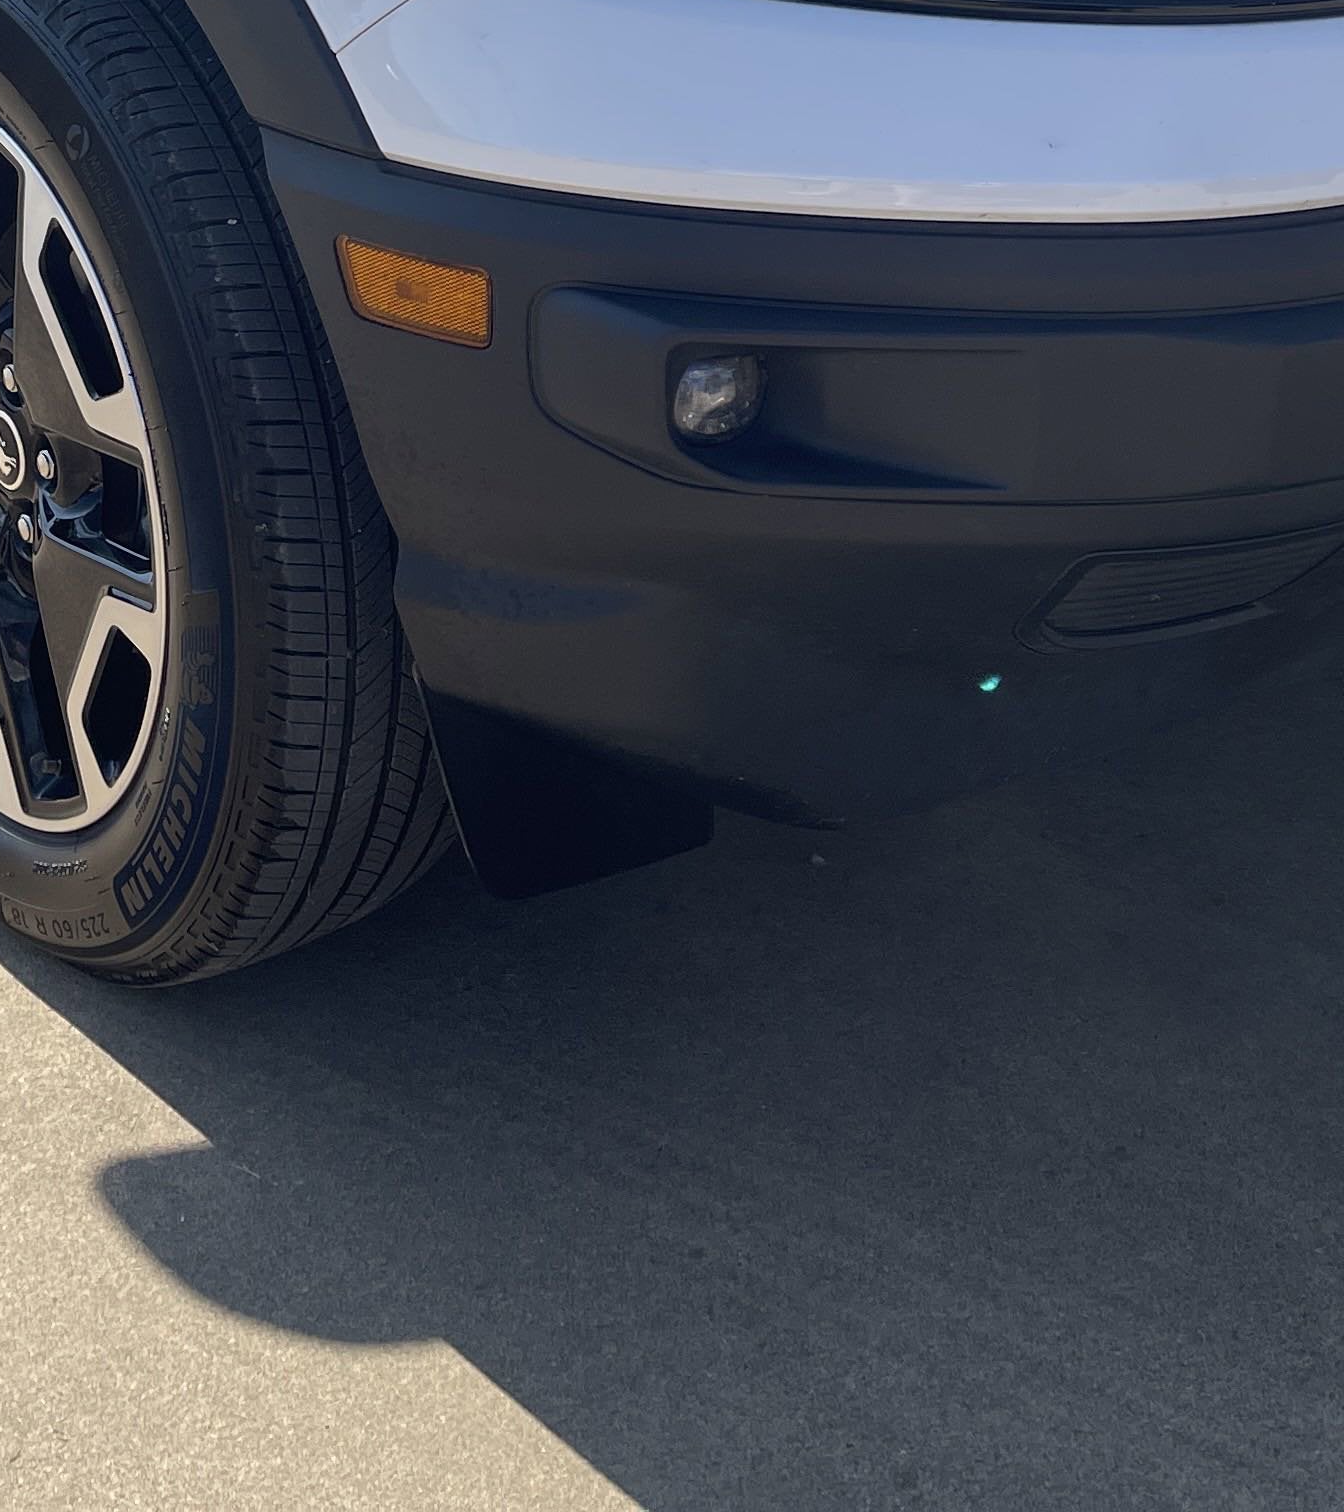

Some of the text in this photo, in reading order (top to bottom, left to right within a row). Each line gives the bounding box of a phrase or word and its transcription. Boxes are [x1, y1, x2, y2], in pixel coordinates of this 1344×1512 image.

[119, 717, 207, 917] MICHELIN
[11, 908, 111, 940] 225/60 R 18
